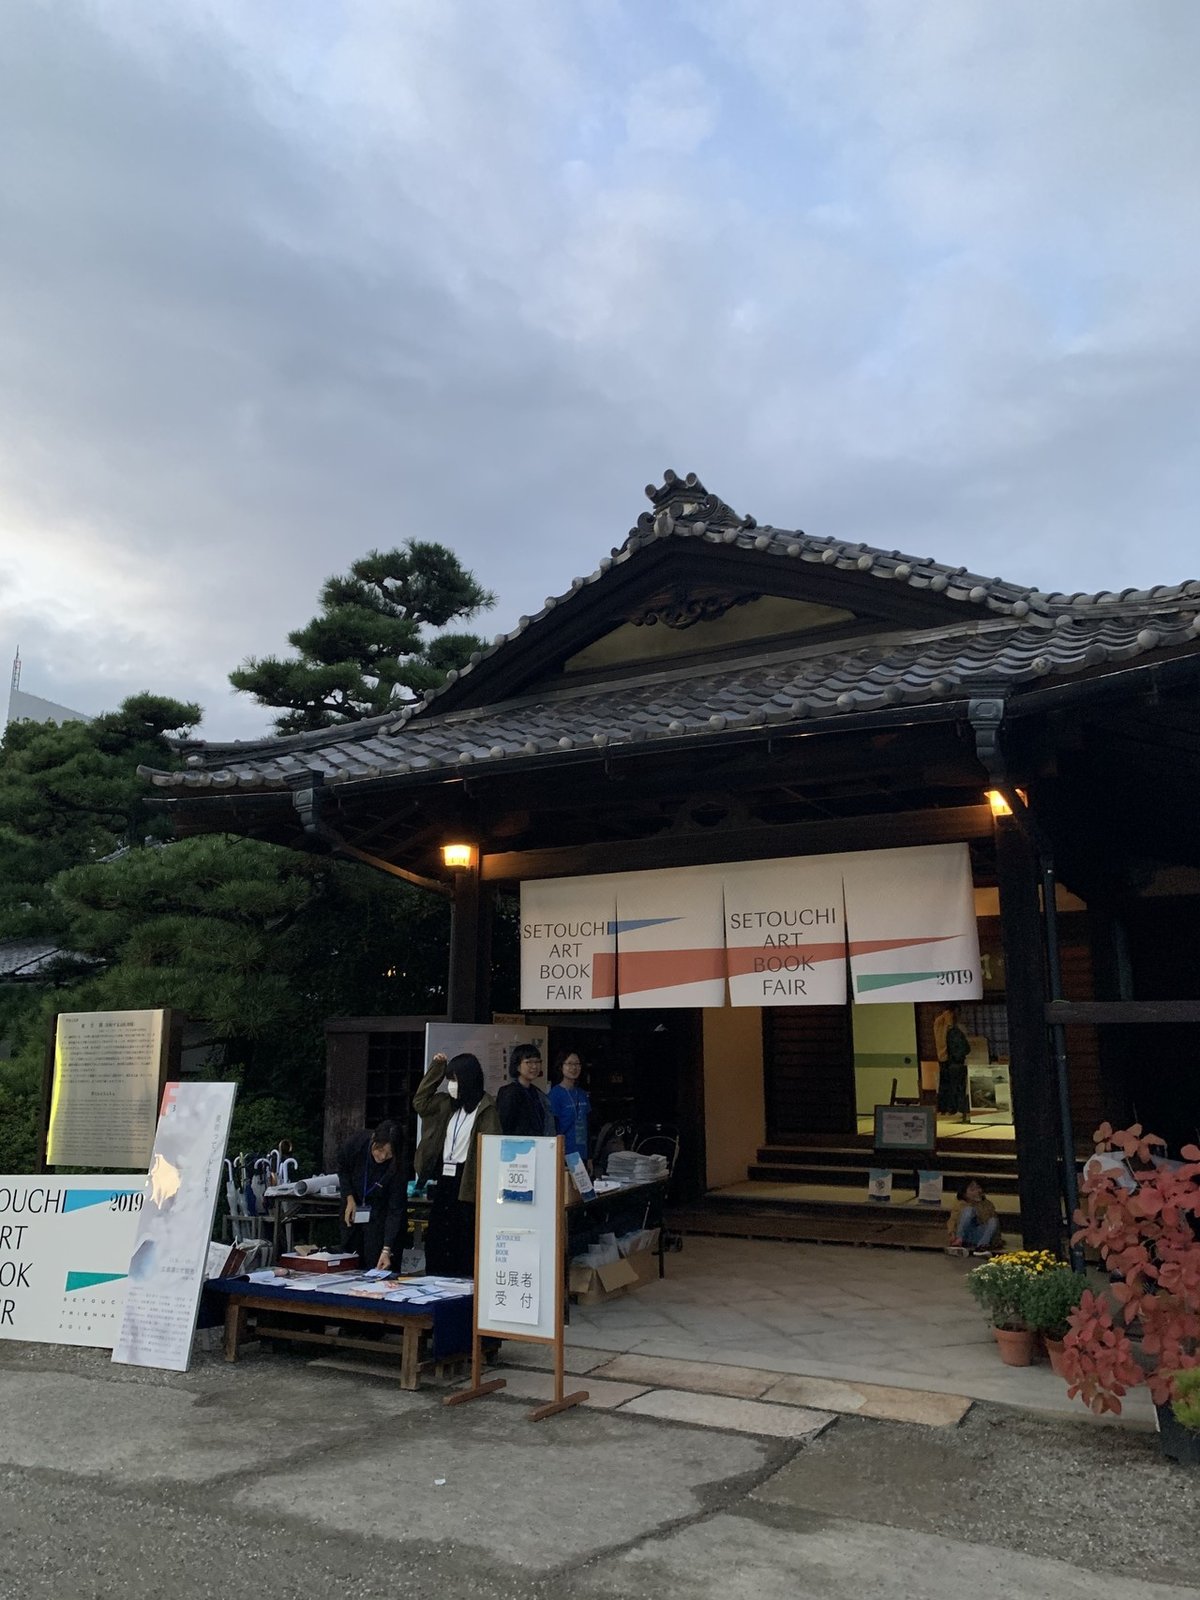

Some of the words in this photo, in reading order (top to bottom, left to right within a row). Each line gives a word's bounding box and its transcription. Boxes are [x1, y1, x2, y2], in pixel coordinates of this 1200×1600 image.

[730, 907, 836, 929] SETOUCHI
[523, 921, 610, 939] SETOUCHI
[763, 932, 803, 950] ART
[548, 943, 583, 958] ART
[540, 963, 591, 979] BOOK
[754, 955, 815, 973] BOOK
[936, 968, 973, 985] 2019
[546, 985, 583, 1000] FAIR
[763, 979, 807, 996] FAIR
[109, 1192, 146, 1212] 2019
[495, 1270, 533, 1288] 出展者
[63, 1297, 123, 1305] SETOUC
[0, 1299, 16, 1325] R
